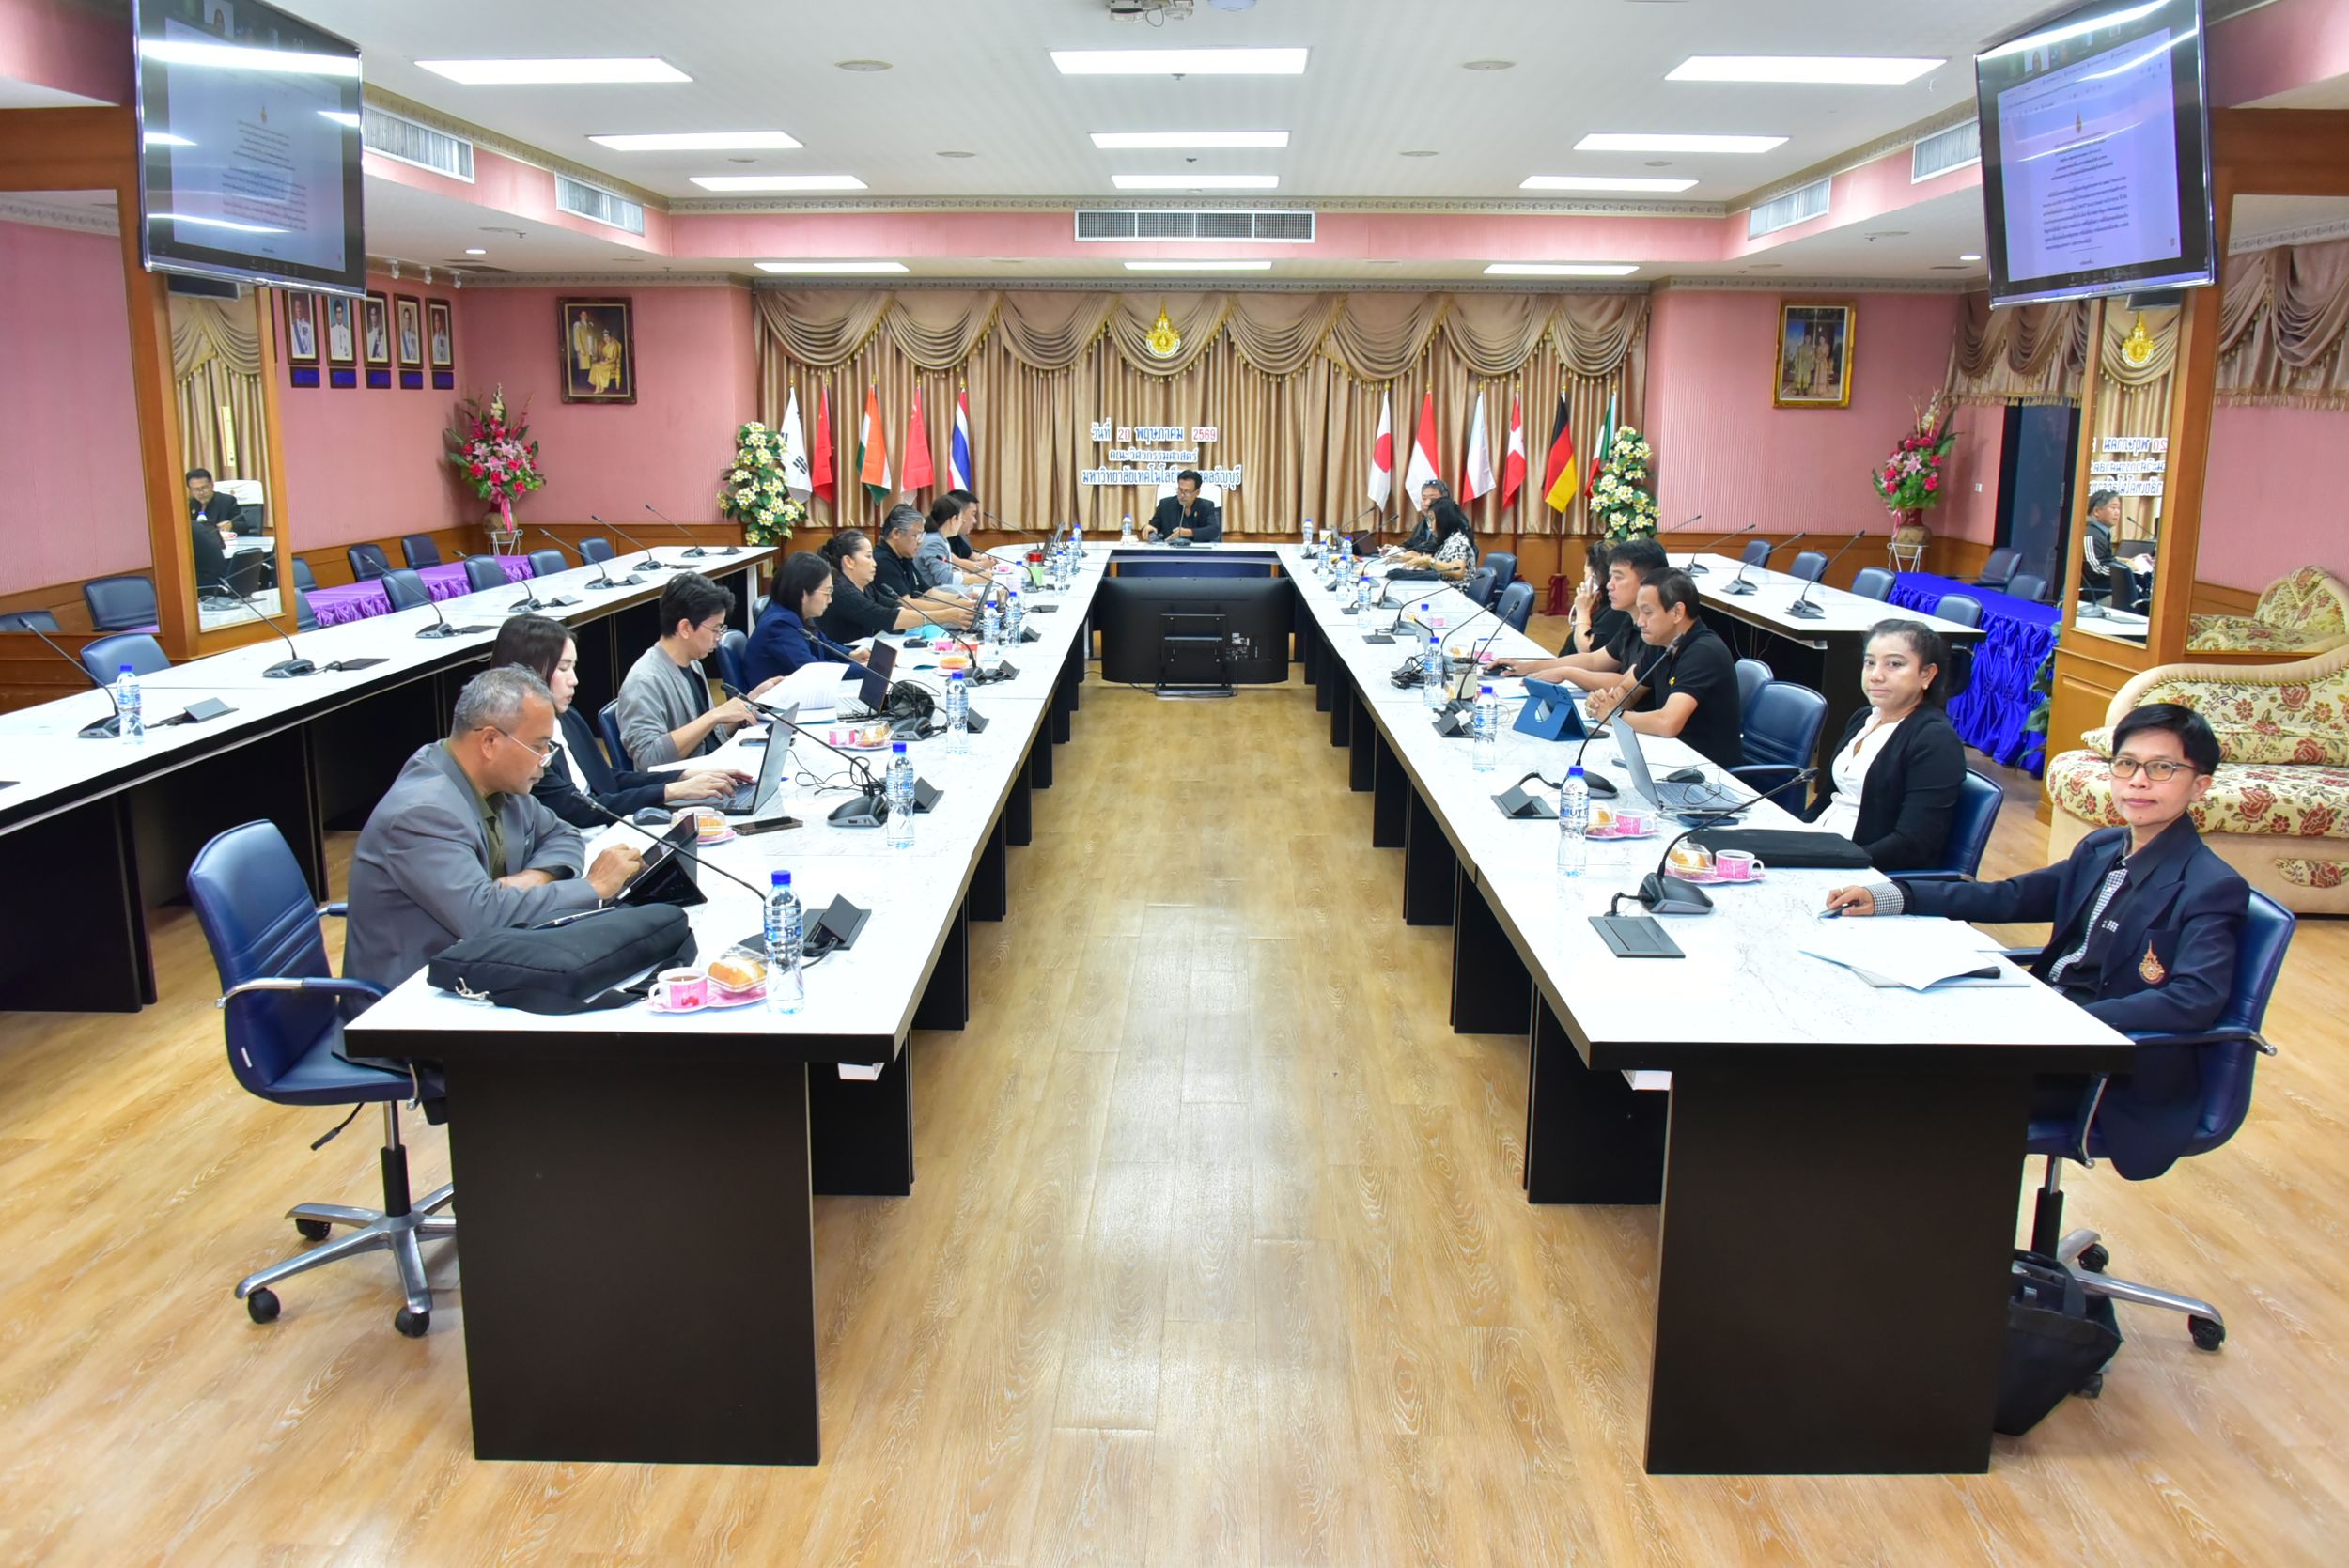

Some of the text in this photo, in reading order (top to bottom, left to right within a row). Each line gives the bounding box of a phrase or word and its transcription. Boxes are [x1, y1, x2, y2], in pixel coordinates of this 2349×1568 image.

[1091, 418, 1217, 444] วันที่ 20 พฤษภาคม 2569
[1109, 448, 1198, 461] คณะวิศวกรรมศาสตร์
[1081, 465, 1241, 489] มหาวิทยาลัยเทคโนโลยีคลธัญบุรี
